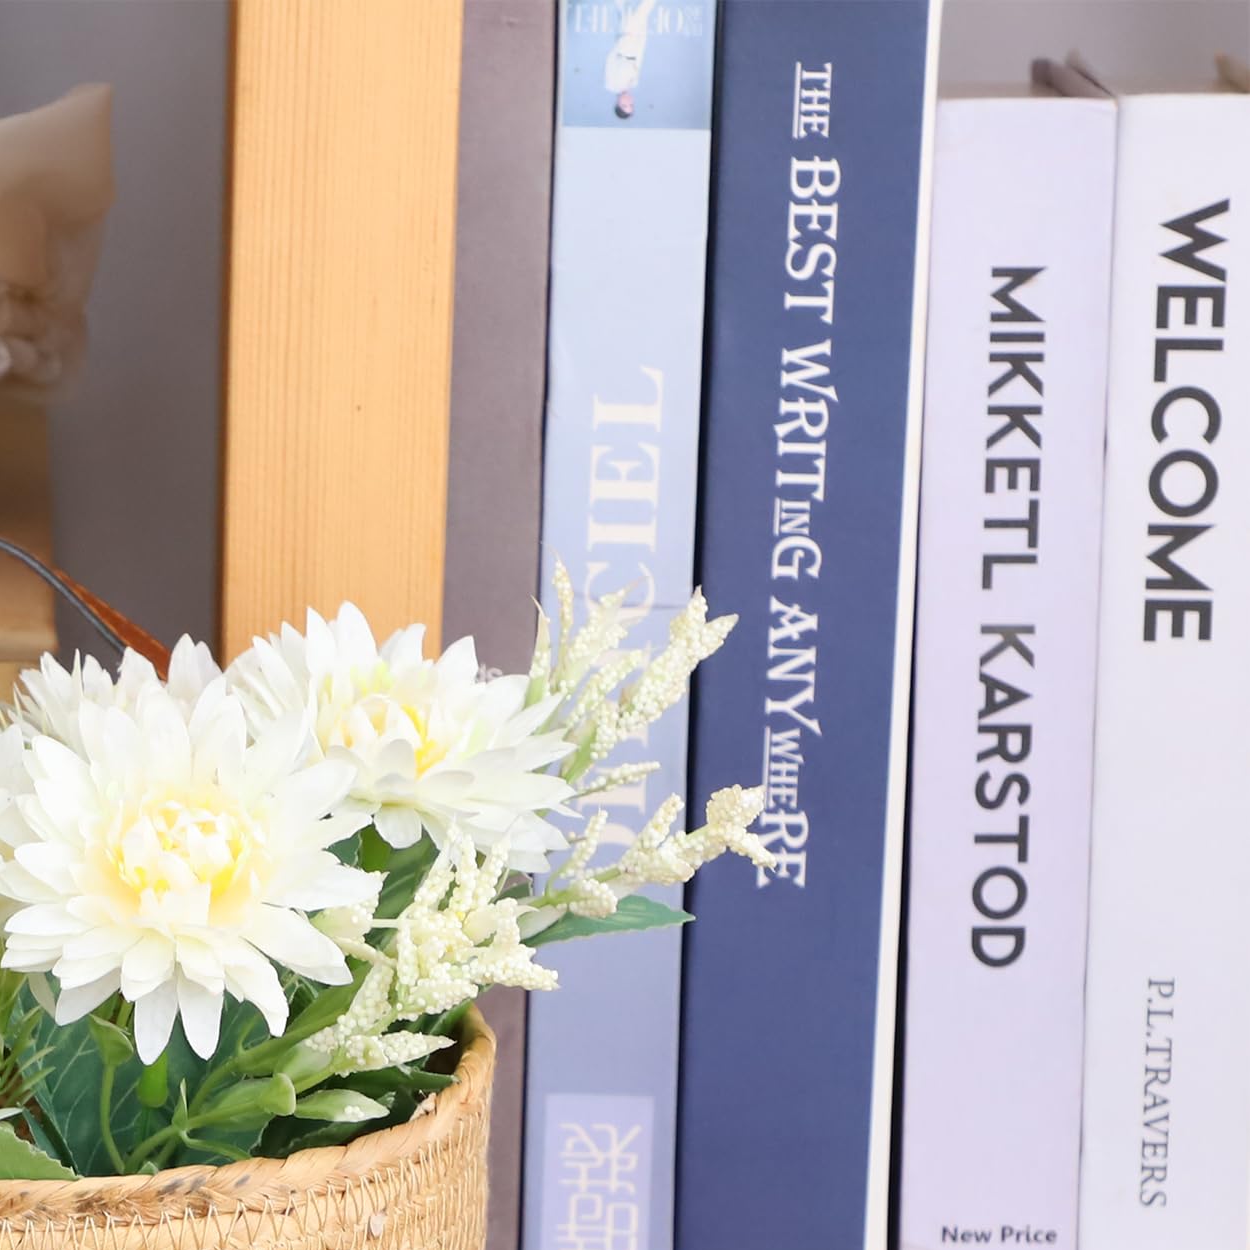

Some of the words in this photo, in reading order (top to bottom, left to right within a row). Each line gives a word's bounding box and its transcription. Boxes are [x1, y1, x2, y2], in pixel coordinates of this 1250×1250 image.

[792, 62, 832, 139] THE
[784, 155, 841, 324] BEST
[772, 338, 839, 580] WRITING
[1143, 198, 1231, 642] WELCOME
[970, 623, 1036, 968] KARSTOD
[941, 1225, 992, 1243] New
[1001, 1224, 1058, 1244] Price
